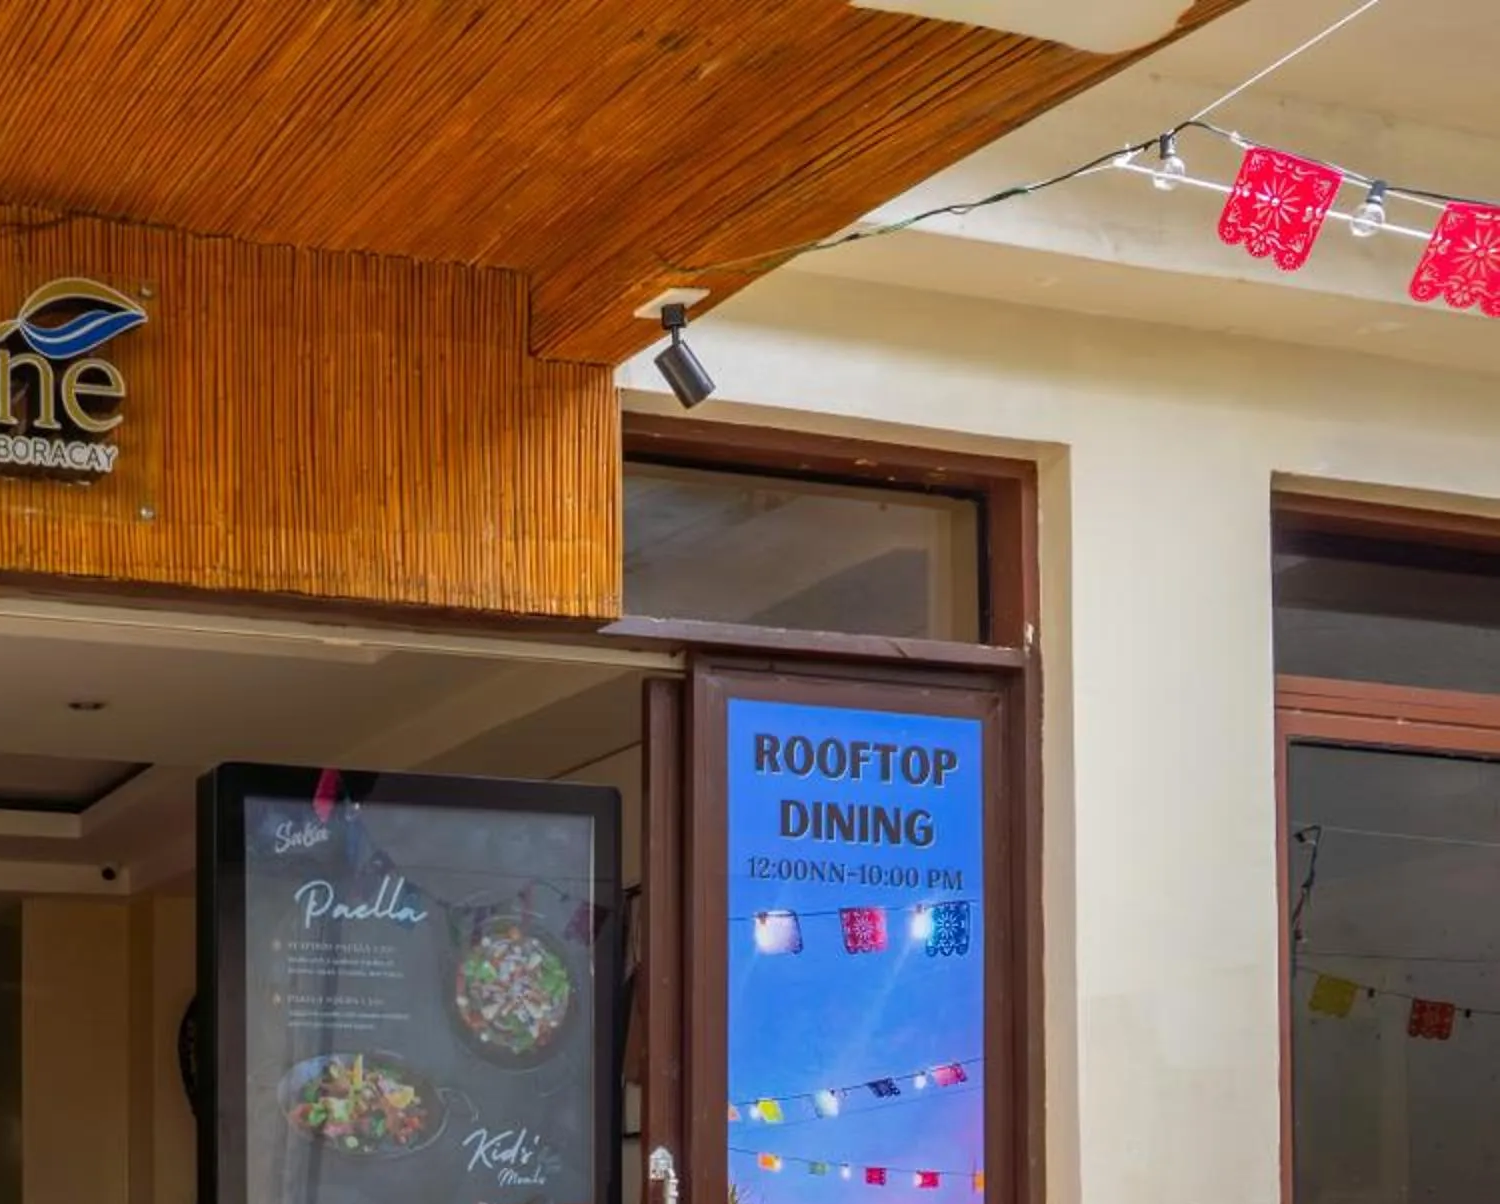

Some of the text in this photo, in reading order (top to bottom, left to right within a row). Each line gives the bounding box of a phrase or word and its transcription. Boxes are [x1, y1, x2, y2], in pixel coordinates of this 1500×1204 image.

[753, 732, 959, 788] ROOFTOP
[779, 798, 936, 848] DINING
[294, 875, 429, 929] Paella
[927, 869, 964, 891] PM
